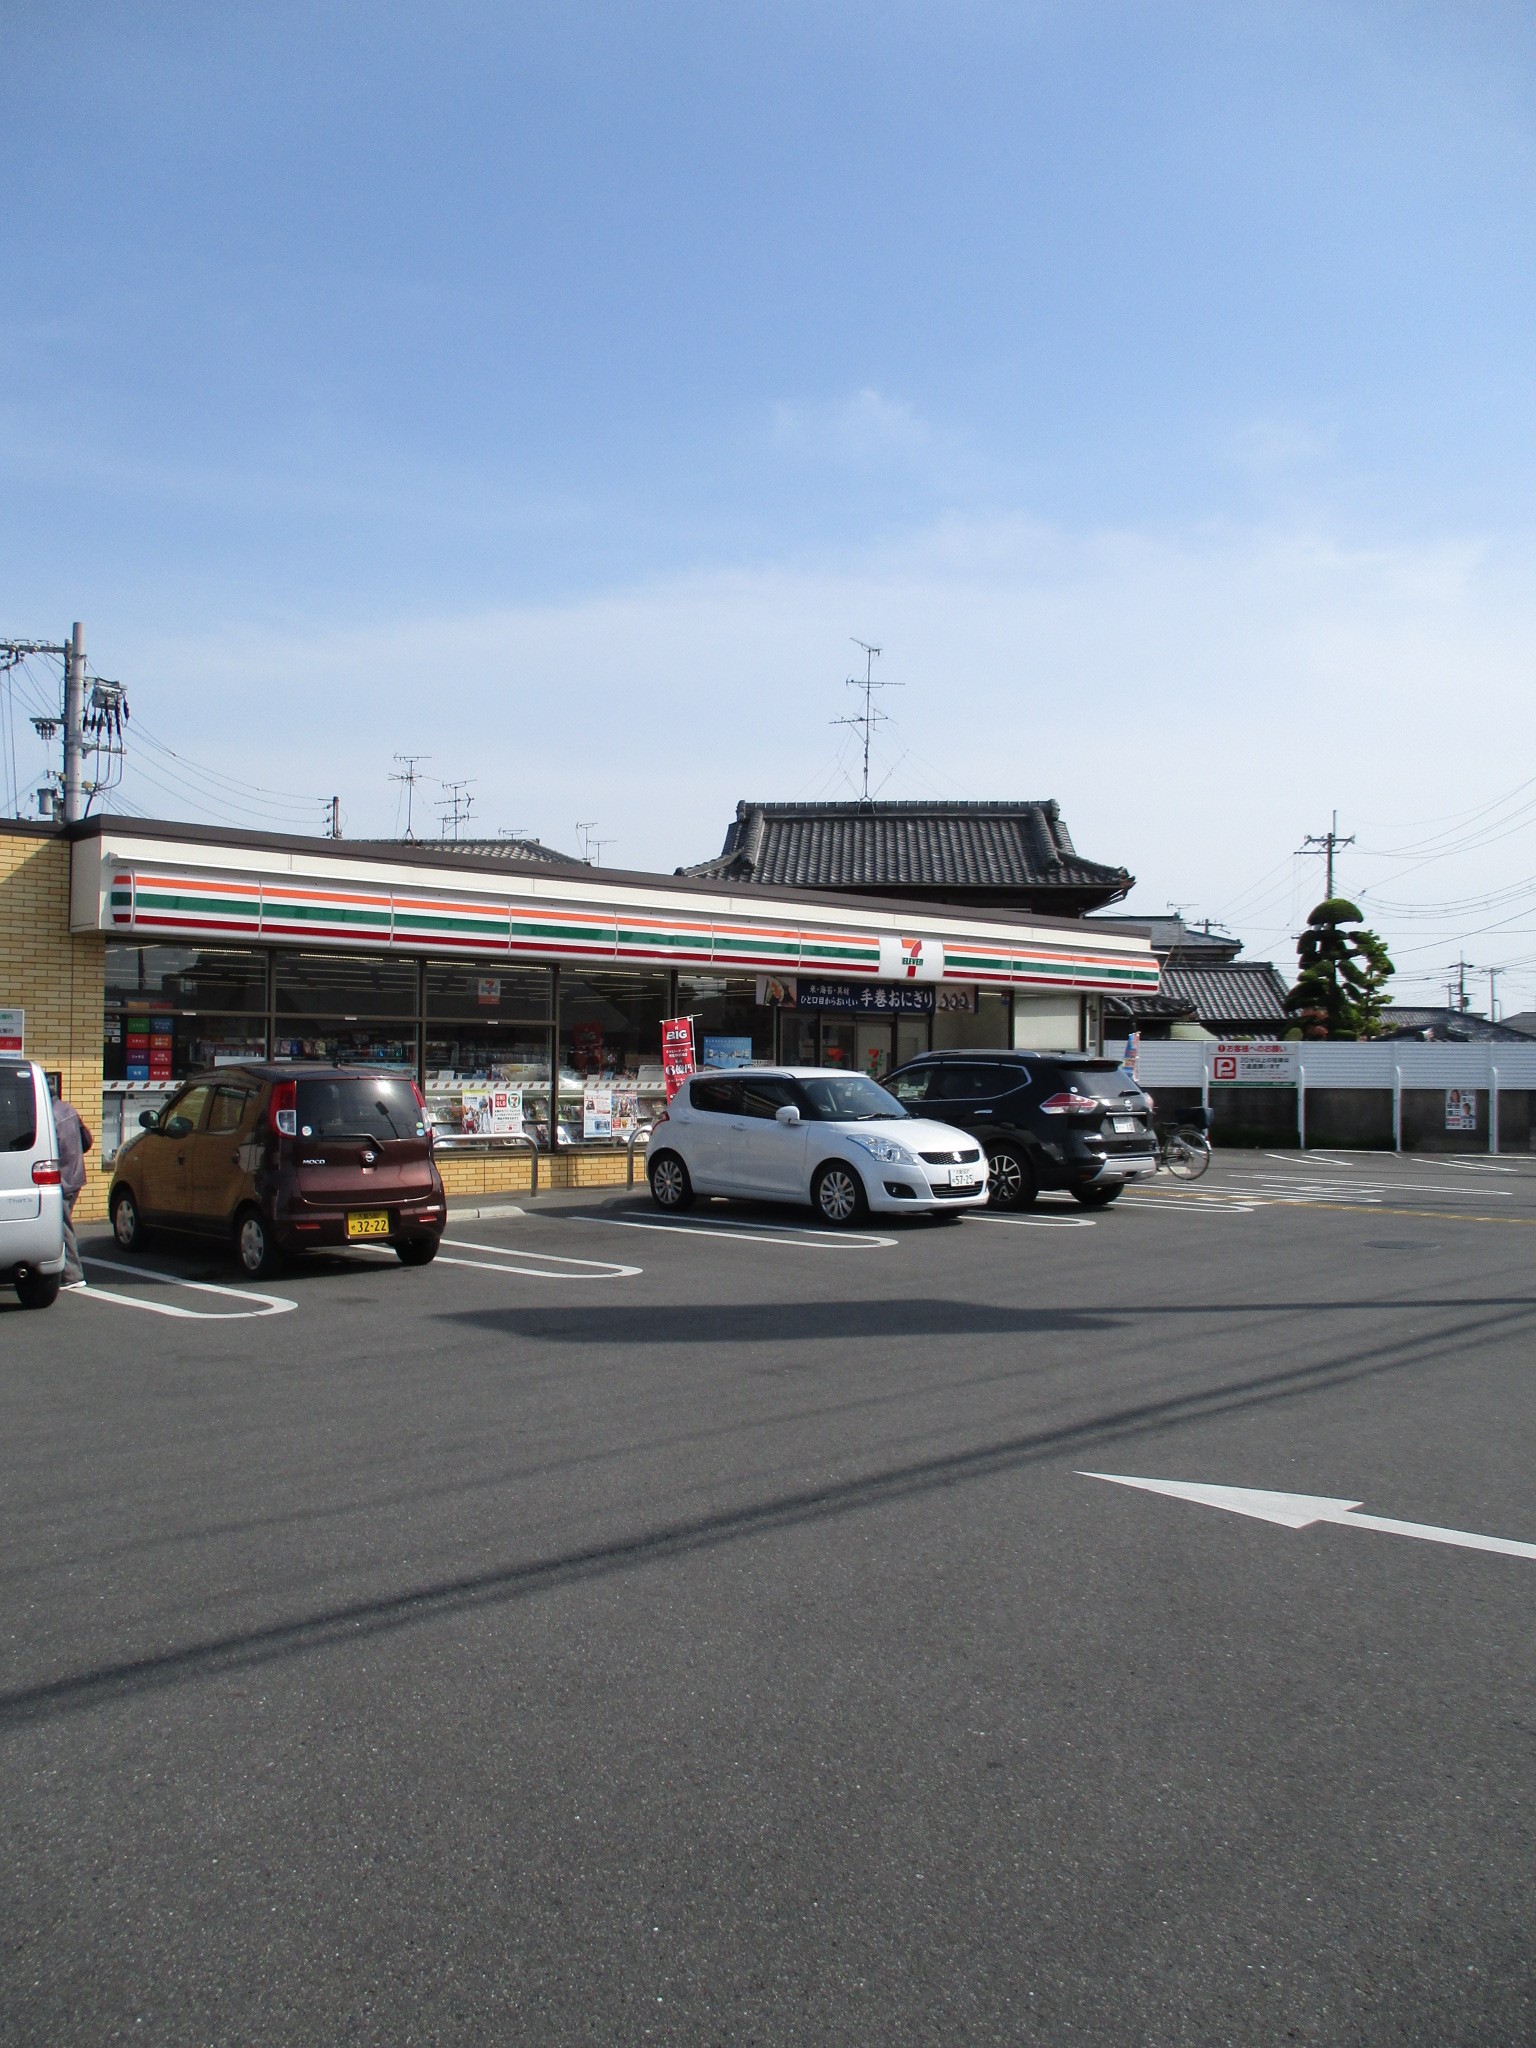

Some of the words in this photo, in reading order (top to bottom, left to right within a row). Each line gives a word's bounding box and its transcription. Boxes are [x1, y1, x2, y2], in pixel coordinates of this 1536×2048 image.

[800, 995, 859, 1007] ひと口目からおいしい
[860, 987, 933, 1009] 手巻おにぎり
[666, 1029, 688, 1041] BIG
[1226, 1045, 1287, 1053] お客様へのお願い
[955, 1174, 974, 1185] 57-25
[357, 1219, 387, 1233] 32-22
